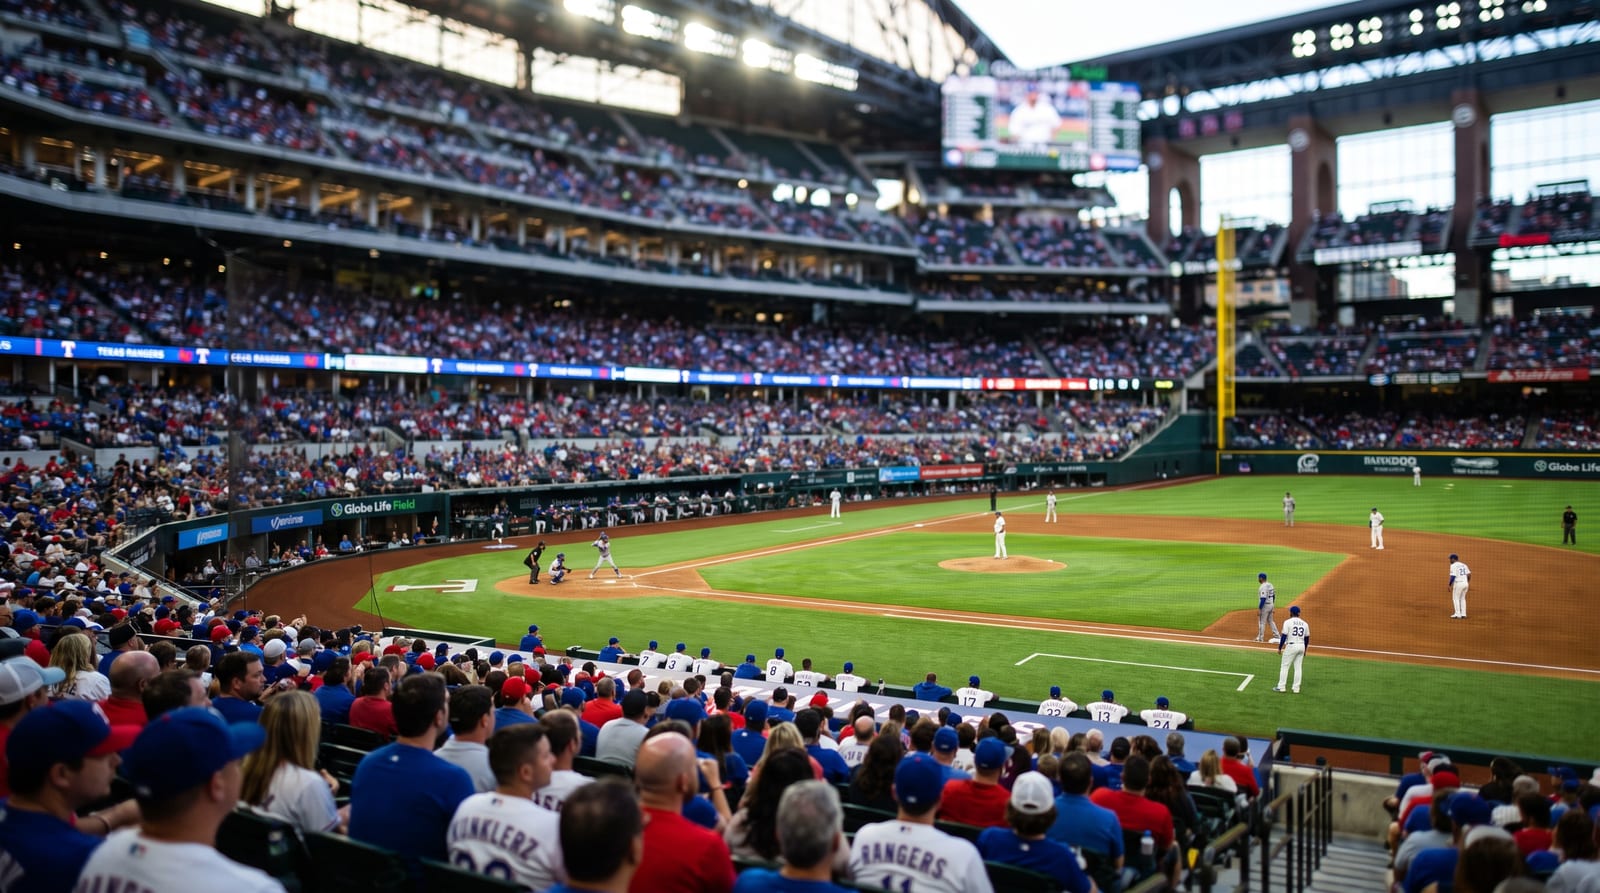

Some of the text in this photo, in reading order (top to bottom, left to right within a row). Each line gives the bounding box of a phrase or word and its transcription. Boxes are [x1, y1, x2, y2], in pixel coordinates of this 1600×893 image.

[61, 340, 76, 358] T
[195, 348, 210, 364] T
[1548, 462, 1580, 472] Globe
[344, 498, 415, 514] Globe Life Field
[1292, 627, 1304, 637] 33
[641, 656, 649, 666] 7
[668, 660, 676, 669] 3
[770, 666, 777, 676] 8
[964, 697, 976, 707] 17
[1098, 711, 1110, 722] 13
[1154, 720, 1170, 729] 24
[861, 842, 948, 879] RANGERS
